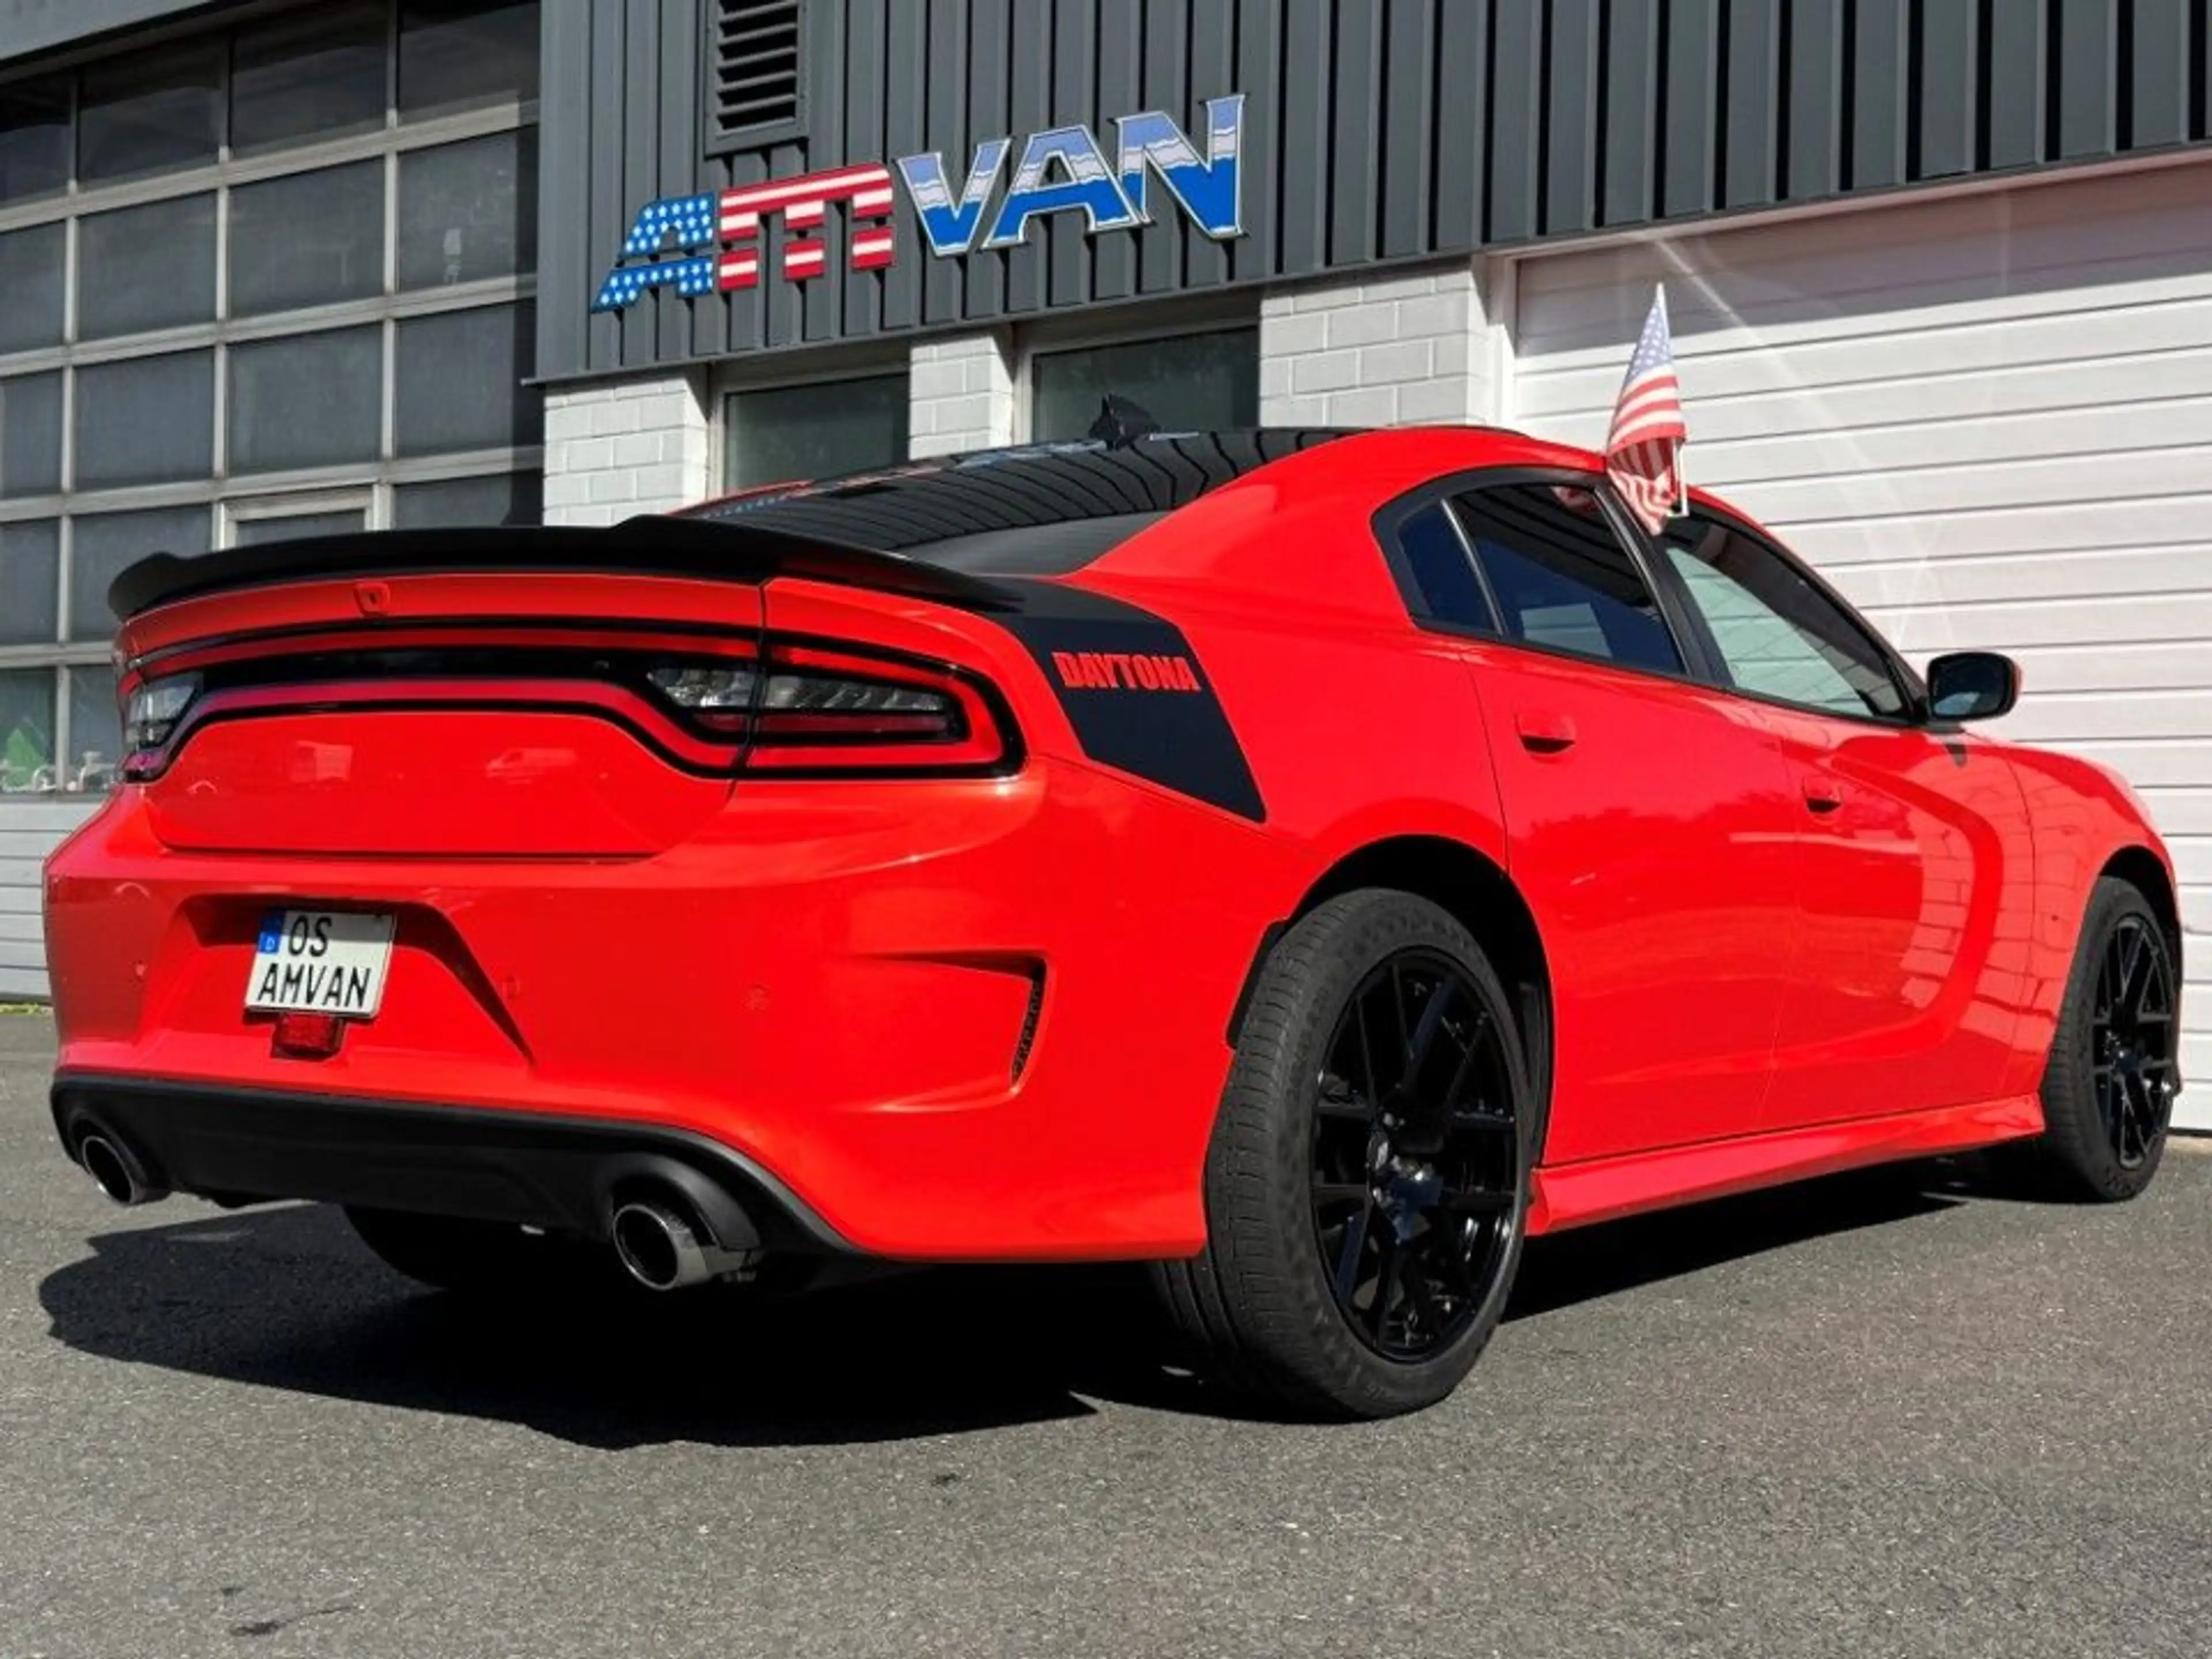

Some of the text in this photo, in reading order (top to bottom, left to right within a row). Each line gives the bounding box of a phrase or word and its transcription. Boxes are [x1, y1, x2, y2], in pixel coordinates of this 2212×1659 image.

[1051, 652, 1202, 690] DAYTONA
[289, 914, 332, 957] OS
[257, 963, 371, 1008] AMVAN
